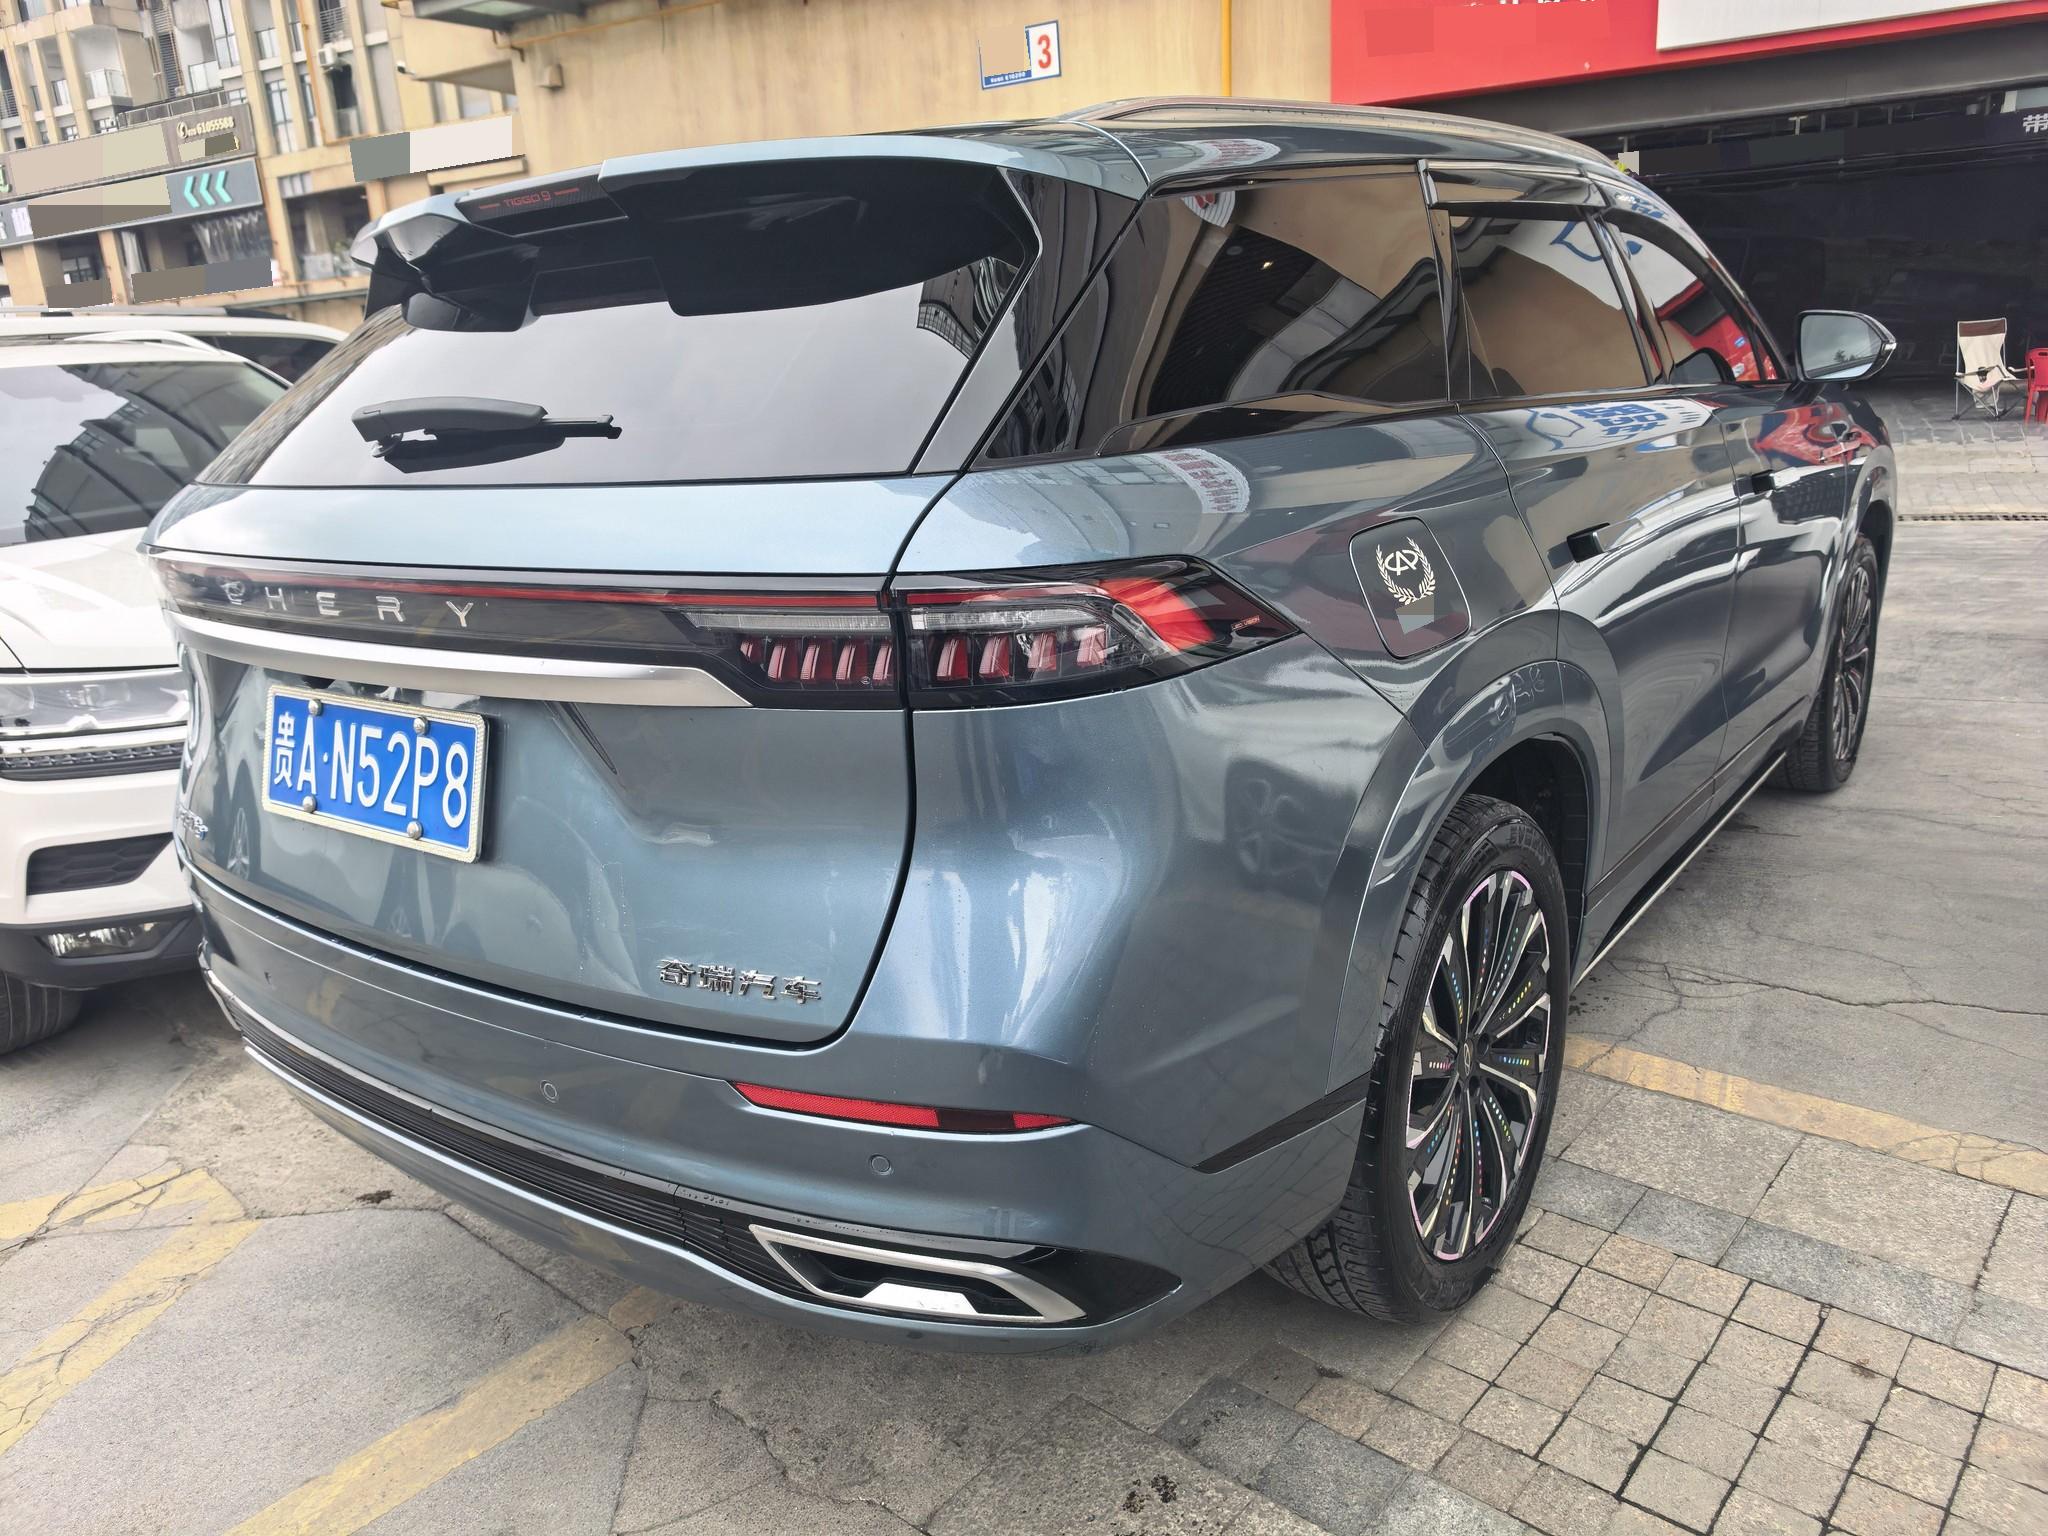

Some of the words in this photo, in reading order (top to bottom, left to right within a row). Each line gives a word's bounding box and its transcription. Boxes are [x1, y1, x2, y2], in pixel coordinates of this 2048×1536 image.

[1037, 34, 1052, 69] 3
[221, 581, 475, 628] CHERY
[656, 958, 822, 1004] 奇瑞汽车
